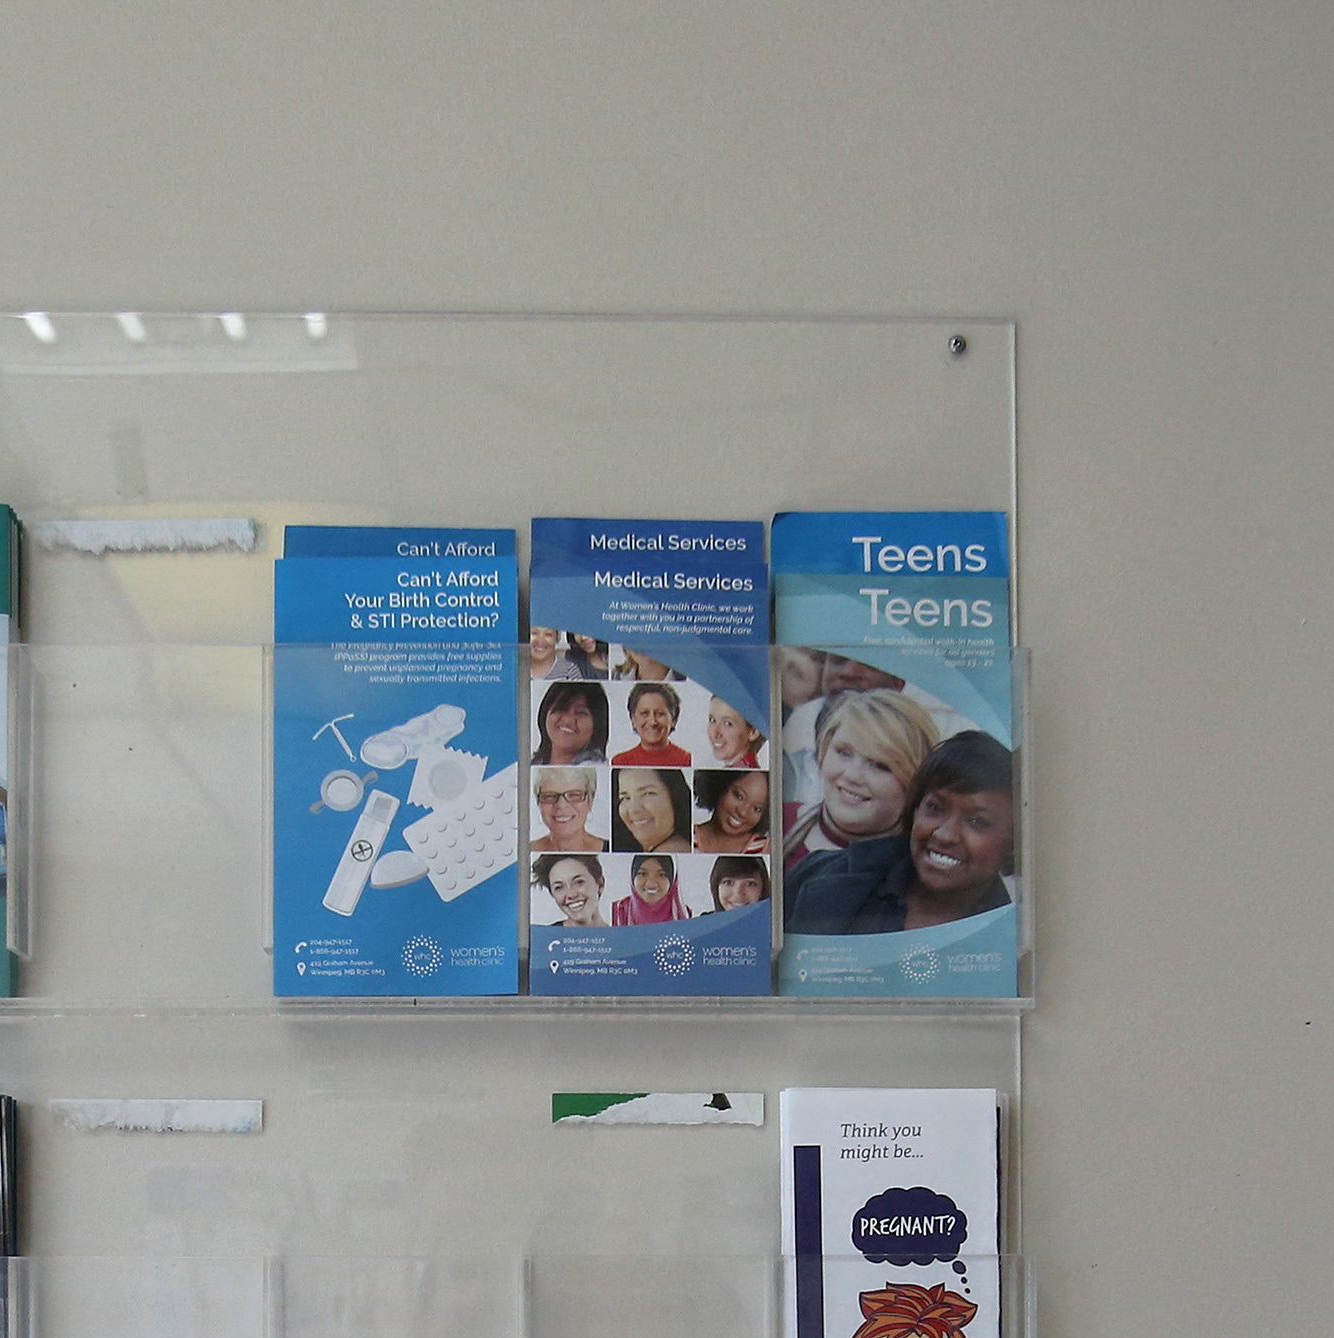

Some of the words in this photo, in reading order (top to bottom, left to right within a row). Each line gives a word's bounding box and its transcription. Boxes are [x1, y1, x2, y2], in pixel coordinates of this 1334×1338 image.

[397, 542, 440, 557] Can't
[444, 541, 496, 557] Afford
[590, 534, 664, 550] Medical
[668, 534, 747, 551] Services
[852, 536, 988, 573] Teens
[397, 571, 442, 587] Can't
[446, 571, 499, 587] Afford
[594, 571, 669, 589] Medical
[673, 573, 754, 591] Services
[344, 593, 385, 608] Your
[389, 592, 430, 608] Birth
[435, 592, 500, 608] Control
[859, 588, 993, 628] Teens
[350, 614, 363, 629] &
[368, 613, 395, 628] STI
[400, 613, 499, 628] Protection?
[840, 1123, 888, 1138] Think
[890, 1125, 922, 1141] you
[840, 1144, 889, 1163] might
[893, 1144, 924, 1159] be...
[860, 1215, 956, 1237] PREGNANT?
